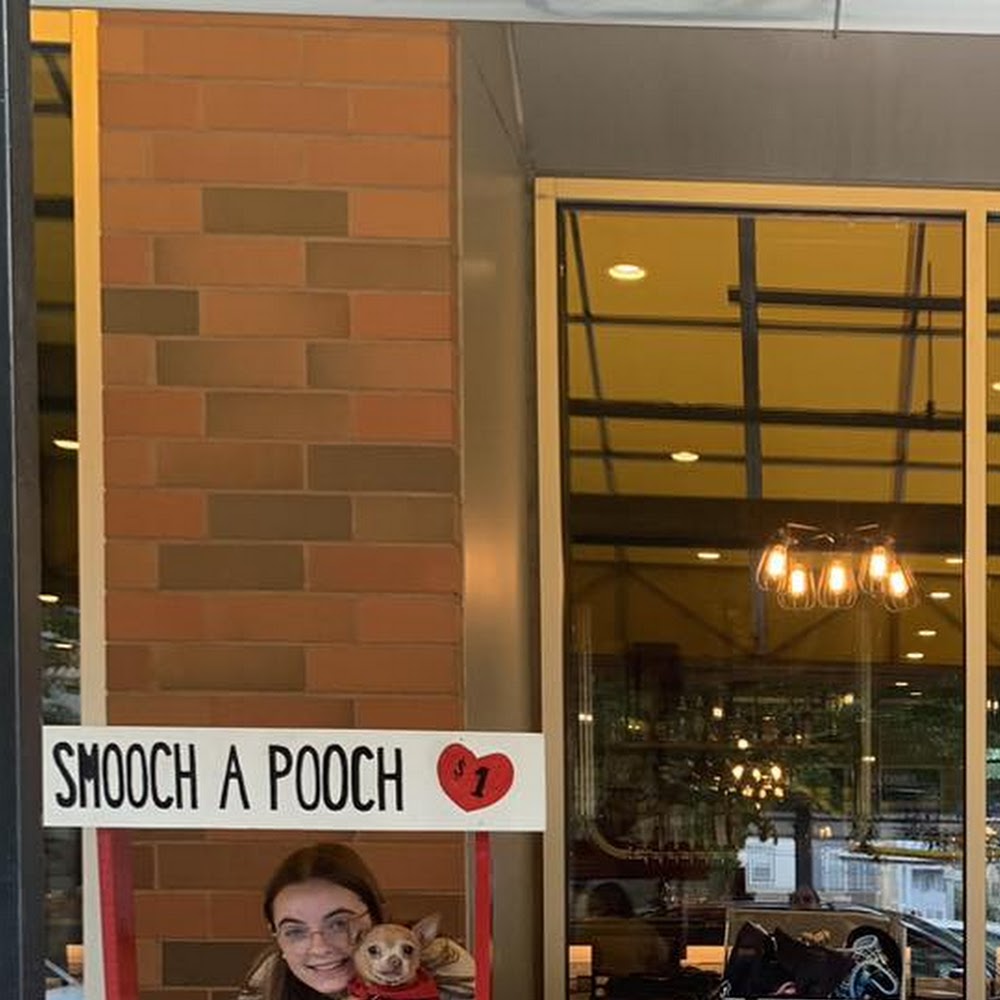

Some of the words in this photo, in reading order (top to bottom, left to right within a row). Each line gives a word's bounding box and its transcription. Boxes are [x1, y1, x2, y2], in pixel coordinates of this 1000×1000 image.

[52, 742, 198, 809] SMOOCH
[219, 744, 251, 810] A
[269, 744, 404, 811] POOCH
